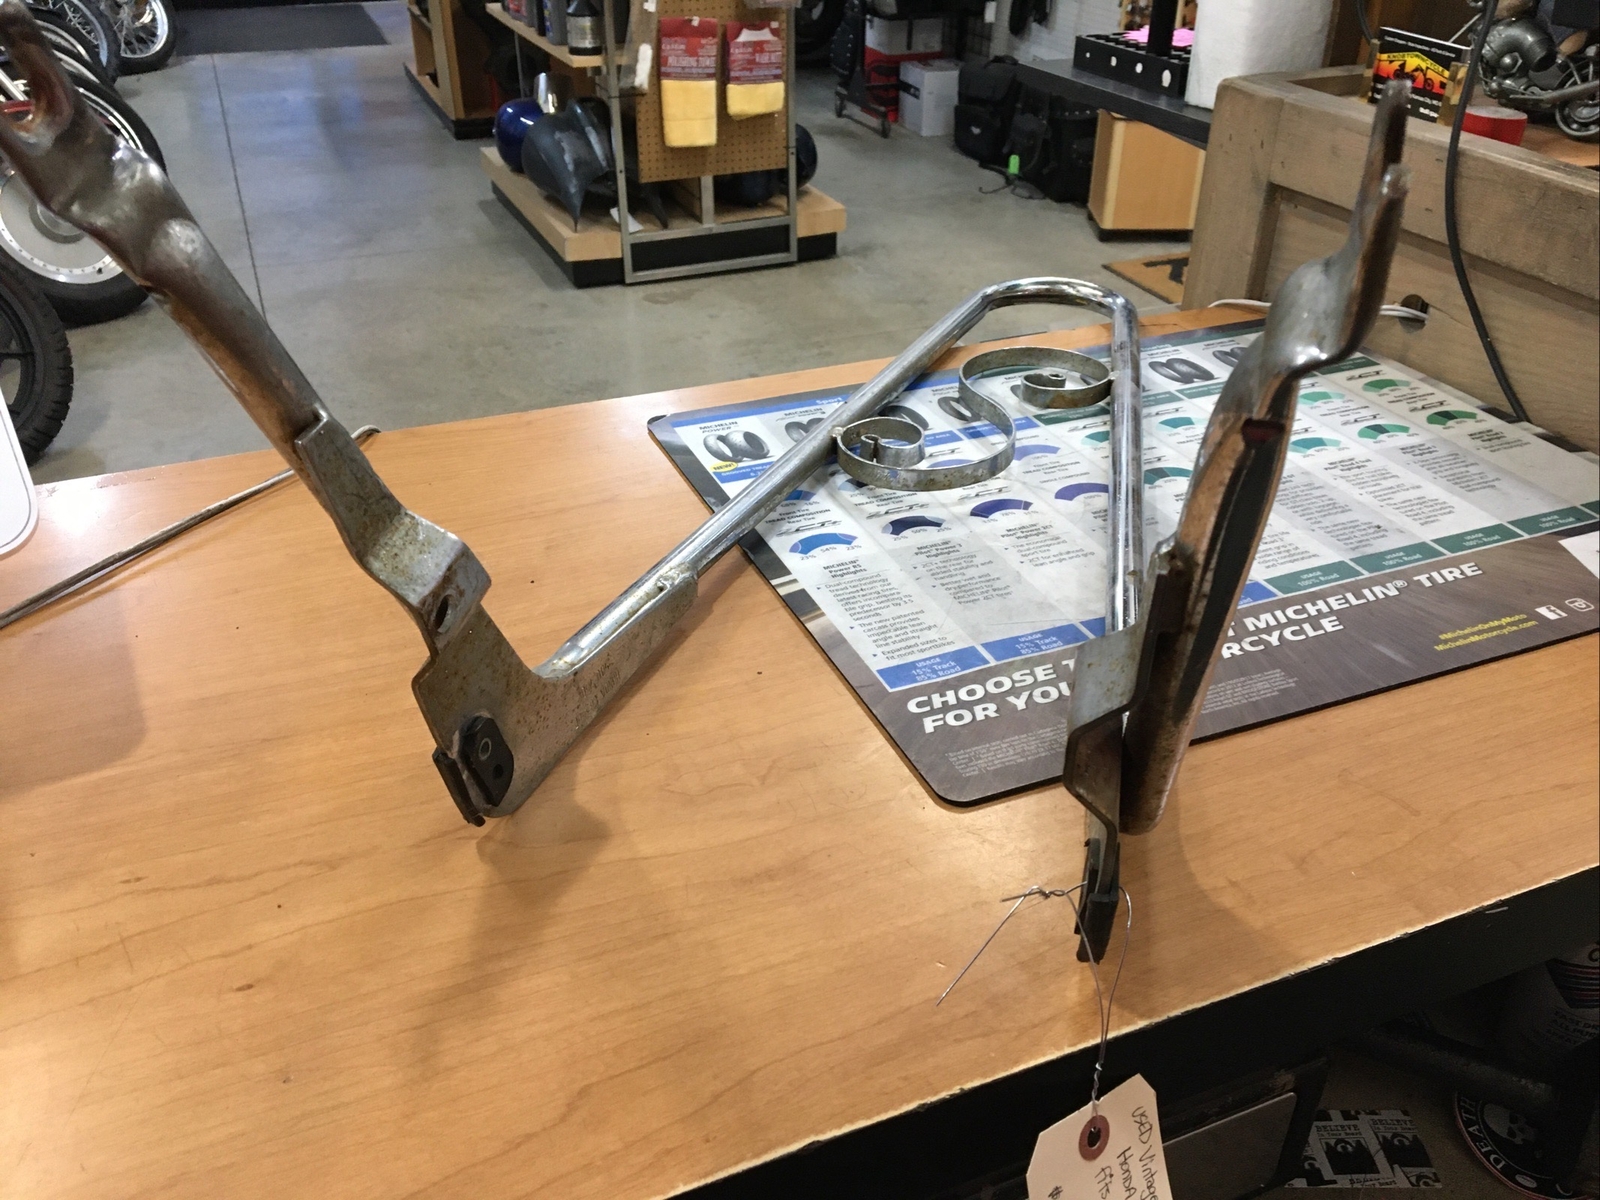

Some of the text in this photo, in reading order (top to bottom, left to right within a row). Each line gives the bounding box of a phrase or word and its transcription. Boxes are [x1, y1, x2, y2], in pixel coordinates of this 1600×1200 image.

[699, 421, 738, 430] MICHELIN
[1404, 553, 1422, 561] Road
[831, 568, 867, 579] Highlights
[1321, 573, 1340, 581] Road
[849, 578, 888, 588] technology
[1245, 578, 1408, 633] MICHELIN®
[1412, 562, 1483, 589] TIRE
[849, 605, 890, 617] predecessor
[891, 609, 925, 621] patented
[863, 617, 920, 633] carcass provides
[1439, 614, 1527, 640] #MichelinOnMyMoto
[867, 626, 908, 638] impeccable
[872, 635, 893, 643] angle
[910, 624, 938, 634] straight
[1018, 633, 1043, 641] USAGE
[1220, 615, 1345, 659] RCYCLE
[1434, 620, 1538, 651] MichelinMotorcycle.com
[891, 634, 920, 645] stability
[1035, 636, 1058, 645] Track
[1041, 641, 1063, 650] Road
[882, 643, 919, 656] Expanded
[896, 650, 916, 658] most
[916, 640, 955, 653] sportbikes
[912, 661, 956, 675] 15% Track
[916, 658, 941, 667] USAGE
[915, 666, 961, 681] 85% Road
[906, 663, 1057, 713] CHOOSE
[922, 681, 1071, 734] FOR YOU
[1131, 1106, 1153, 1145] USED
[1315, 1124, 1360, 1132] BELIEVE
[1371, 1118, 1416, 1126] BELIEVE
